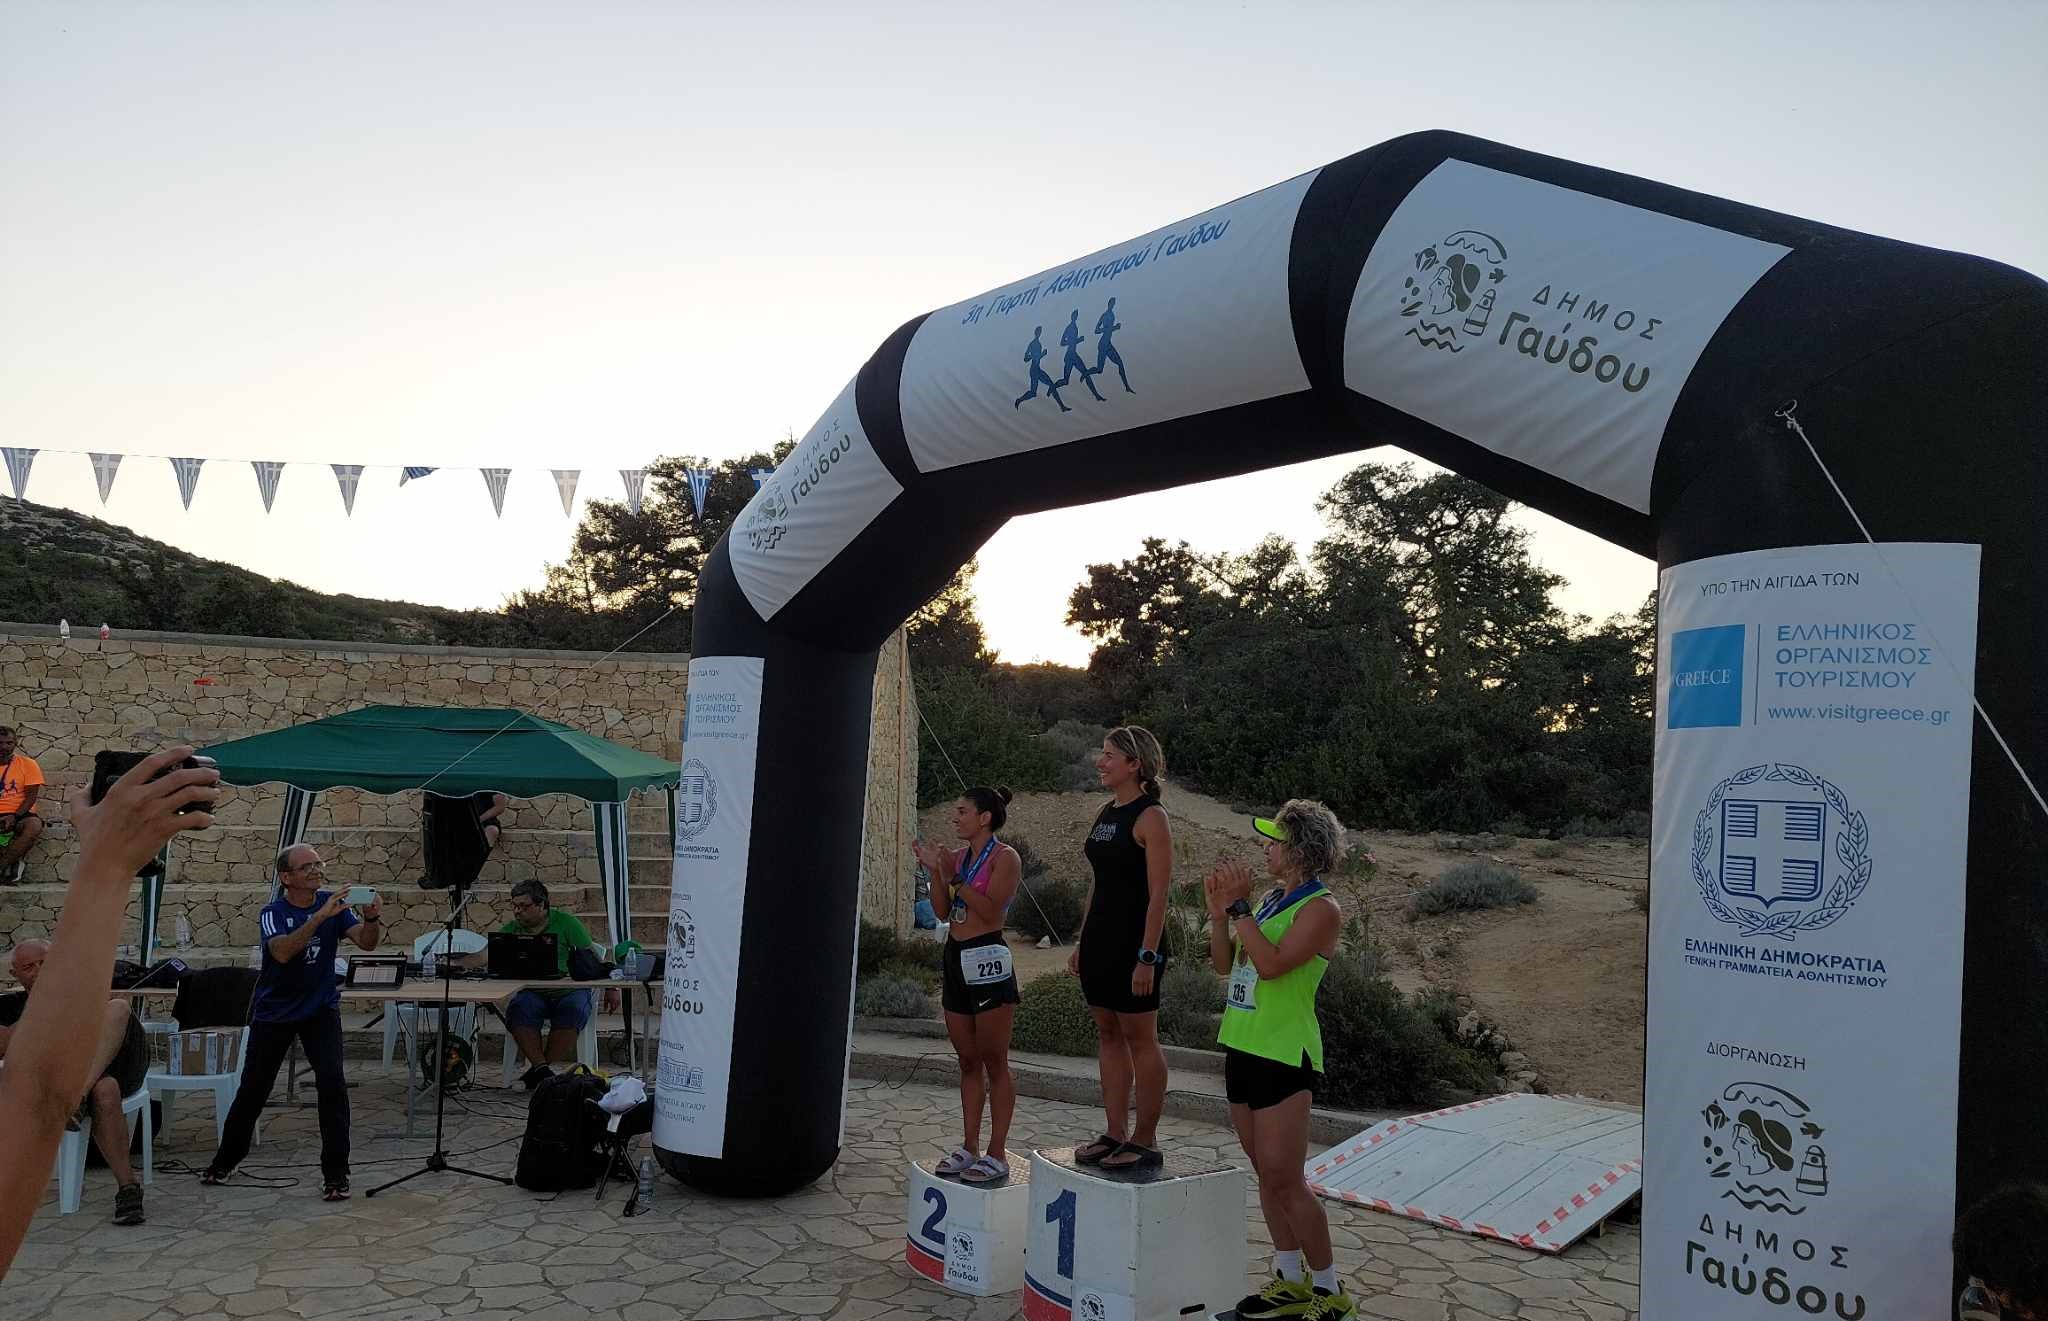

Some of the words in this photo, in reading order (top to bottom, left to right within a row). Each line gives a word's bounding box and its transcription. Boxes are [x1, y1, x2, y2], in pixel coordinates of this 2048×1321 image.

[962, 304, 984, 324] 3η
[1043, 242, 1152, 297] Αθλητισμού
[1153, 219, 1231, 261] Γαύδου
[1532, 284, 1663, 341] ΔΗΜΟΣ
[1498, 311, 1651, 393] Γαύδου
[790, 434, 851, 505] Γαύδου
[1701, 582, 1728, 597] ΥΠΟ
[1730, 577, 1761, 593] ΤΗΝ
[1764, 574, 1818, 589] ΑΙΓΙΔΑ
[1821, 572, 1859, 586] ΤΩΝ
[1777, 622, 1917, 642] ΕΛΛΗΝΙΚΟΣ
[1775, 646, 1933, 666] ΟΡΓΑΝΙΣΜΟΣ
[1774, 670, 1917, 690] ΤΟΥΡΙΣΜΟΥ
[1768, 703, 1951, 727] www.visitgreece.gr
[977, 960, 1003, 978] 229
[1683, 954, 1717, 969] ΓΕΝΙΚΗ
[1719, 959, 1794, 979] ΓΡΑΜΜΑΤΕΙΑ
[1796, 969, 1888, 988] ΑΘΛΗΤΙΣΜΟΥ
[1684, 937, 1756, 960] ΕΛΛΗΝΙΚΗ
[1760, 948, 1887, 974] ΔΗΜΟΚΡΑΤΙΑ
[663, 989, 704, 1015] αύδου
[1706, 1041, 1807, 1072] ΔΙΟΡΓΑΝΩΣΗ
[921, 1186, 948, 1246] 2
[1045, 1188, 1077, 1280] 1
[1699, 1213, 1850, 1269] ΔΗΜΟΣ
[1685, 1240, 1867, 1321] Γαύδου
